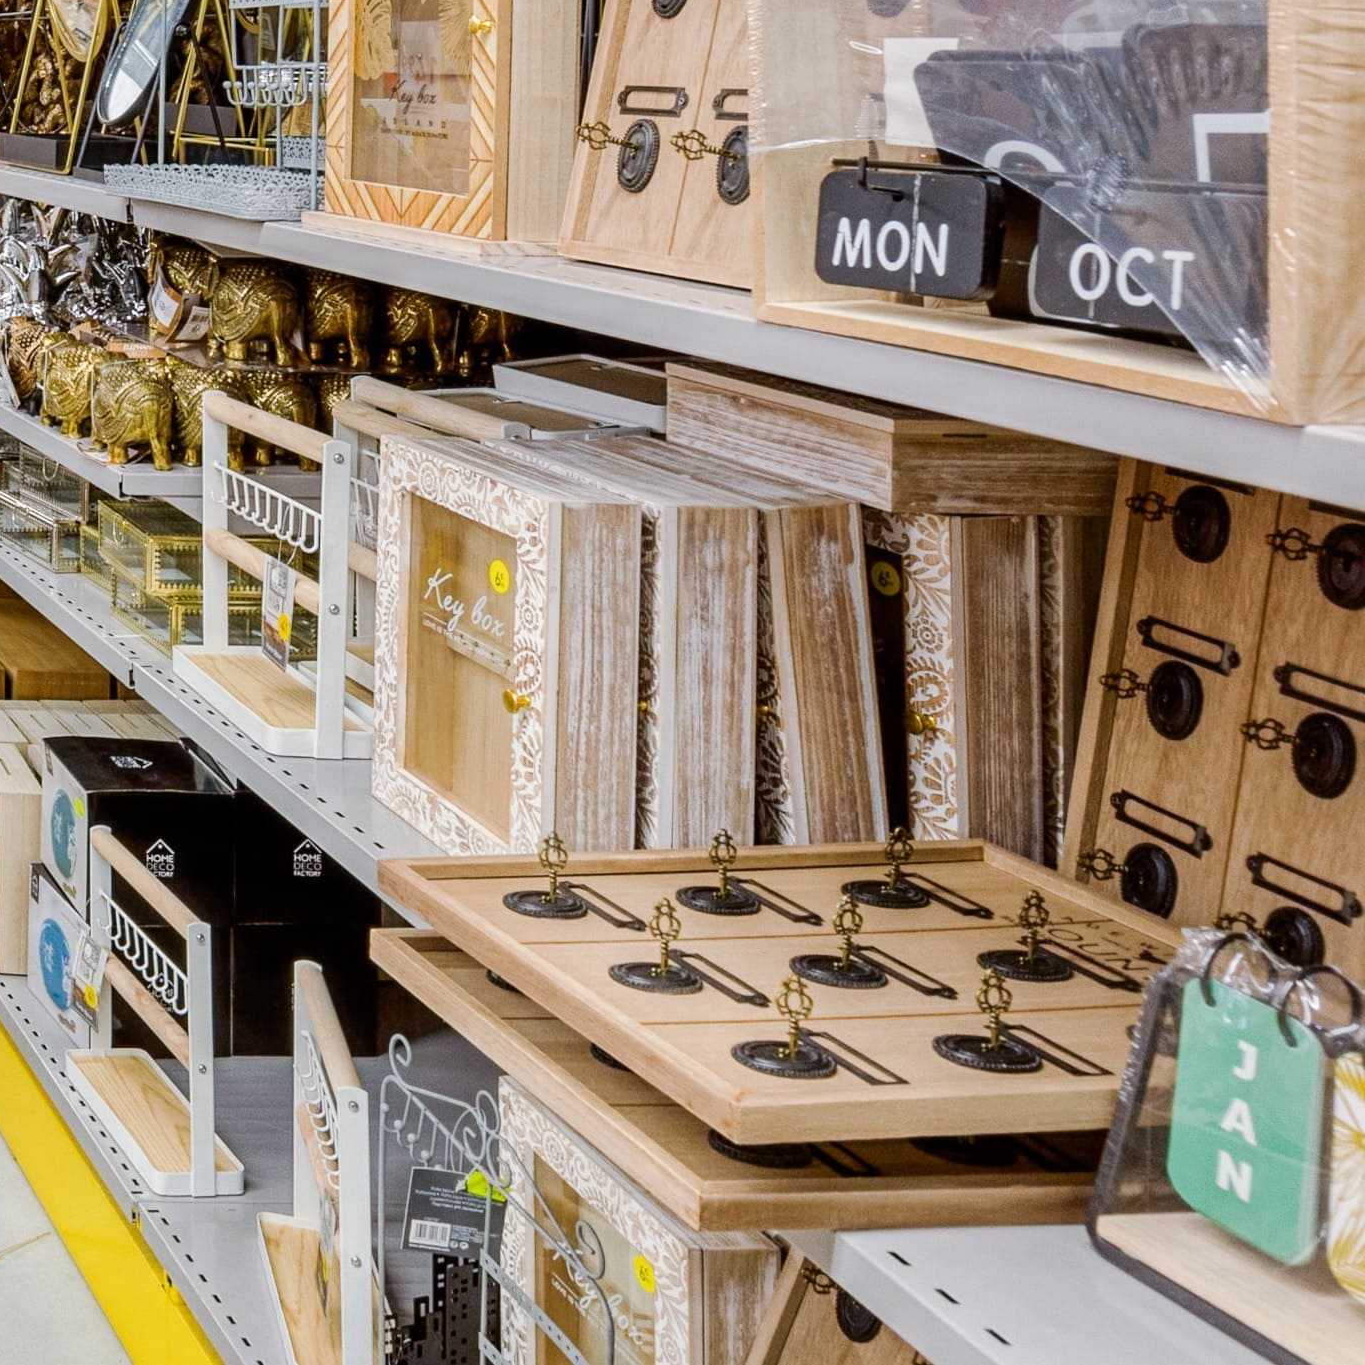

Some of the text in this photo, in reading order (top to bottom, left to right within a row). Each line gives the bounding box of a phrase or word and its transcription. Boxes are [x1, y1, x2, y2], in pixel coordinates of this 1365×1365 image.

[389, 79, 437, 115] Key box
[832, 217, 1195, 310] MON OCT
[424, 568, 505, 636] Key box
[146, 854, 174, 863] HOME
[146, 864, 175, 872] DECO
[294, 854, 321, 863] HOME
[294, 863, 322, 871] DECO
[1216, 1039, 1258, 1204] JAN
